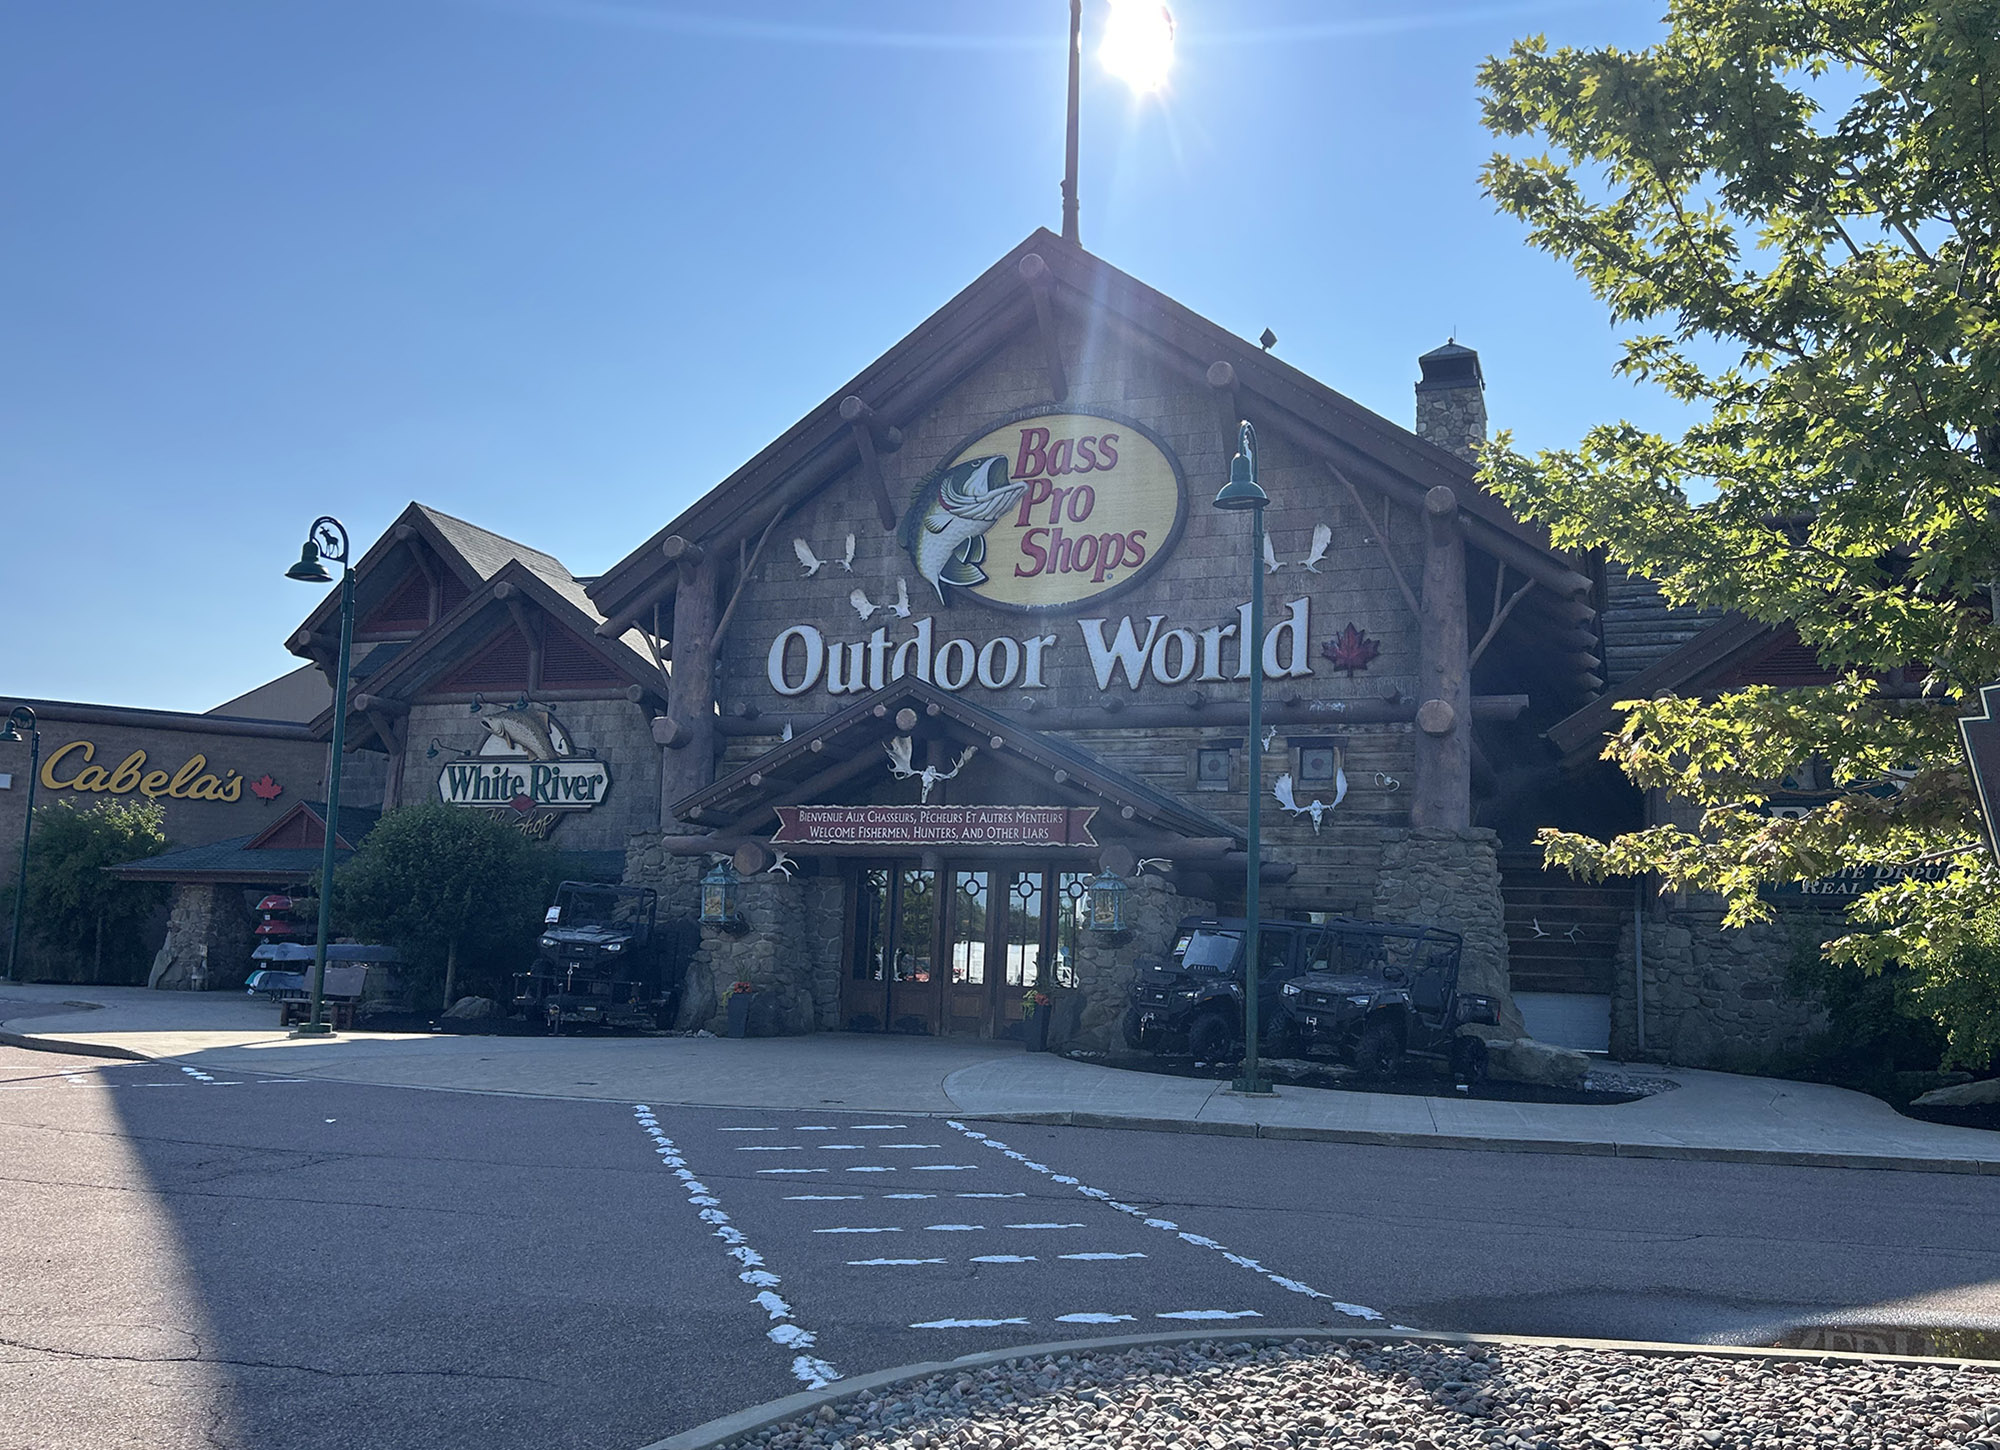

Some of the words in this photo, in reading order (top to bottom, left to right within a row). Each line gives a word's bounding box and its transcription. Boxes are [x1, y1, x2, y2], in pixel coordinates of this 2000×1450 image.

[1010, 427, 1120, 479] Bass
[1014, 478, 1096, 527] Pro
[1014, 528, 1148, 583] Shops
[767, 615, 1058, 696] Outdoor
[1077, 596, 1316, 692] World
[40, 740, 244, 802] Cabela's
[447, 764, 526, 801] White
[529, 764, 604, 804] River
[512, 809, 559, 839] Shop
[799, 810, 844, 823] BIENVENUE
[845, 811, 865, 823] AUX
[867, 810, 917, 825] CHASSEURS,
[920, 811, 963, 824] PÊCHEURS
[966, 811, 976, 824] ET
[979, 811, 1013, 824] AUTRES
[1015, 811, 1064, 824] MENTEURS
[810, 825, 855, 839] WELCOME
[858, 826, 911, 840] FISHERMEN,
[913, 826, 959, 840] HUNTERS,
[961, 827, 984, 839] AND
[986, 826, 1020, 840] OTHER
[1022, 827, 1049, 840] LIARS
[1800, 879, 1862, 895] REAL
